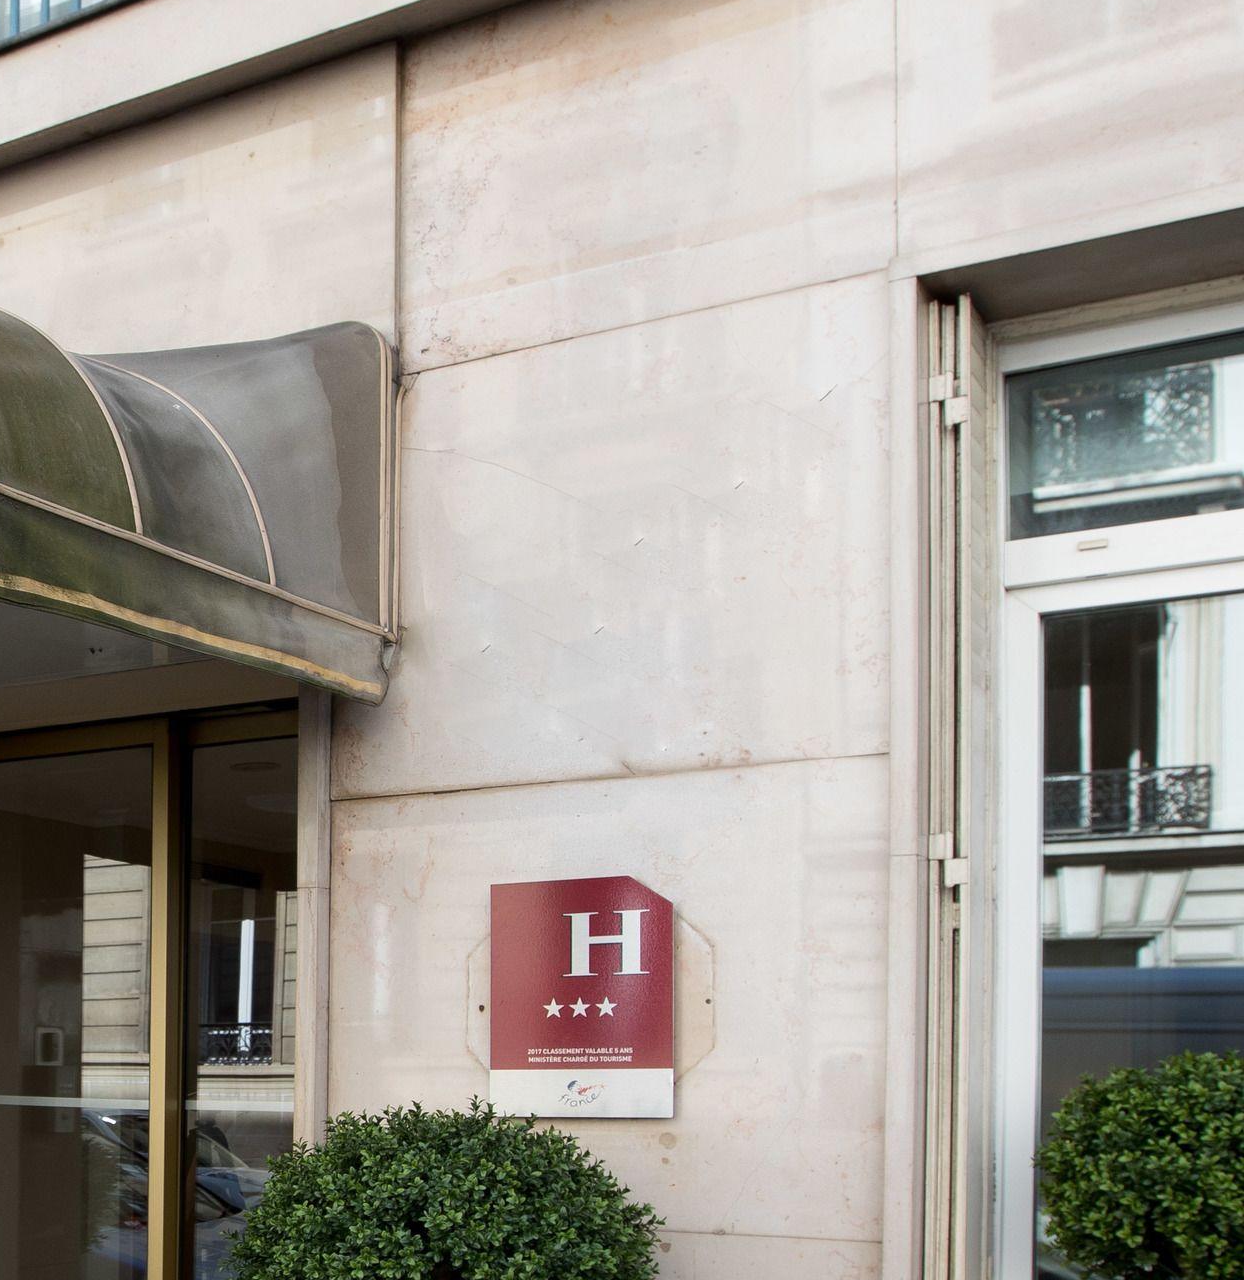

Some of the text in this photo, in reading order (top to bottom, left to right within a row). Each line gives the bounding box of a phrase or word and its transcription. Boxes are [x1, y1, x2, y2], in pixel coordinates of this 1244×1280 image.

[562, 908, 651, 977] H
[542, 1047, 584, 1055] CLASSEMENT
[528, 1055, 562, 1063] MINISTÈRE
[562, 1055, 589, 1063] CHARGÉ
